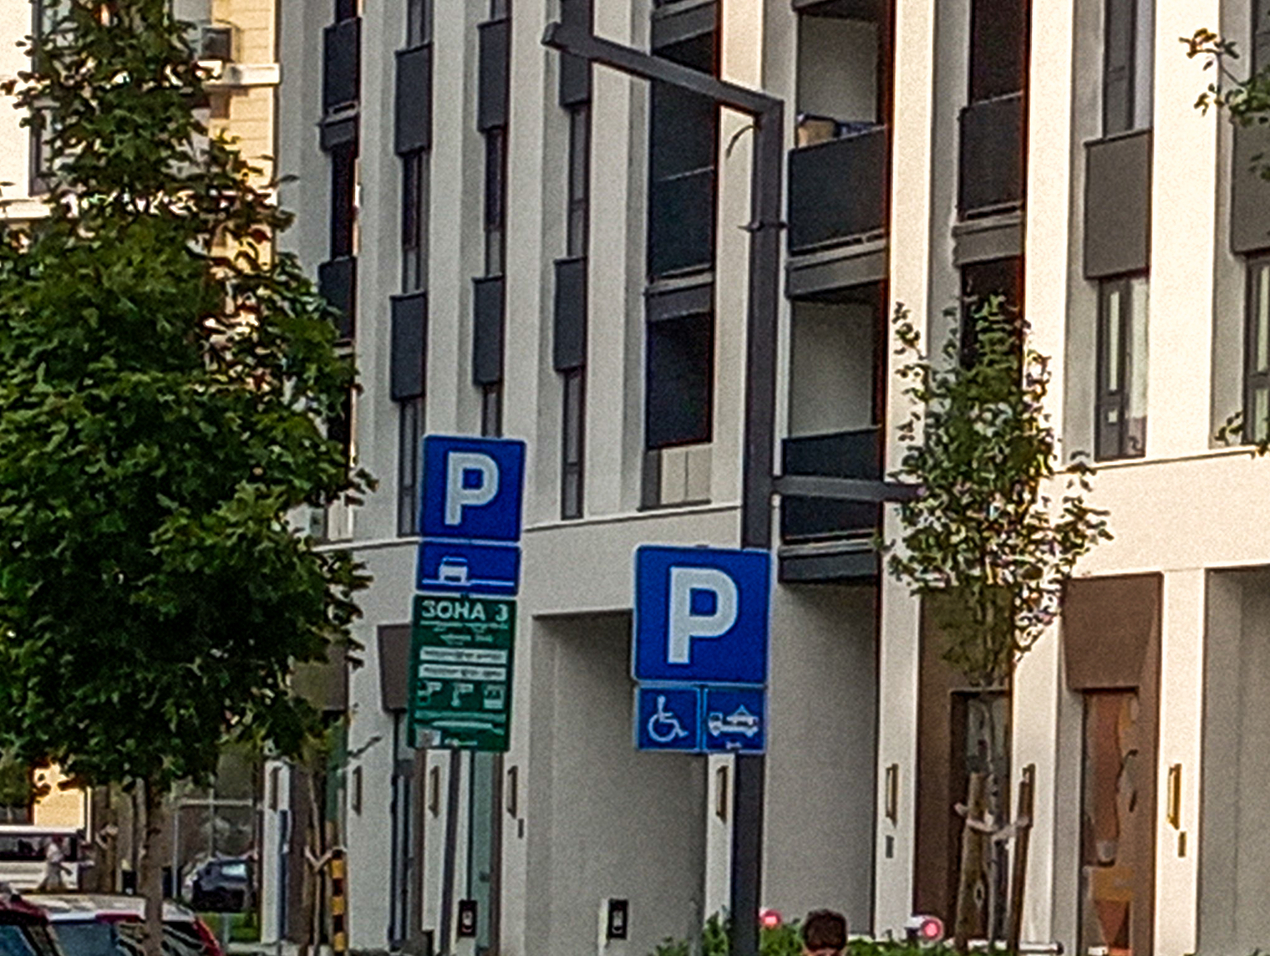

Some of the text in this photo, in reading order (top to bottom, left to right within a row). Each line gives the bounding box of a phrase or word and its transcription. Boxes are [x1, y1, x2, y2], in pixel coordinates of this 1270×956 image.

[444, 450, 501, 526] P
[495, 603, 509, 622] 3
[666, 566, 738, 664] P
